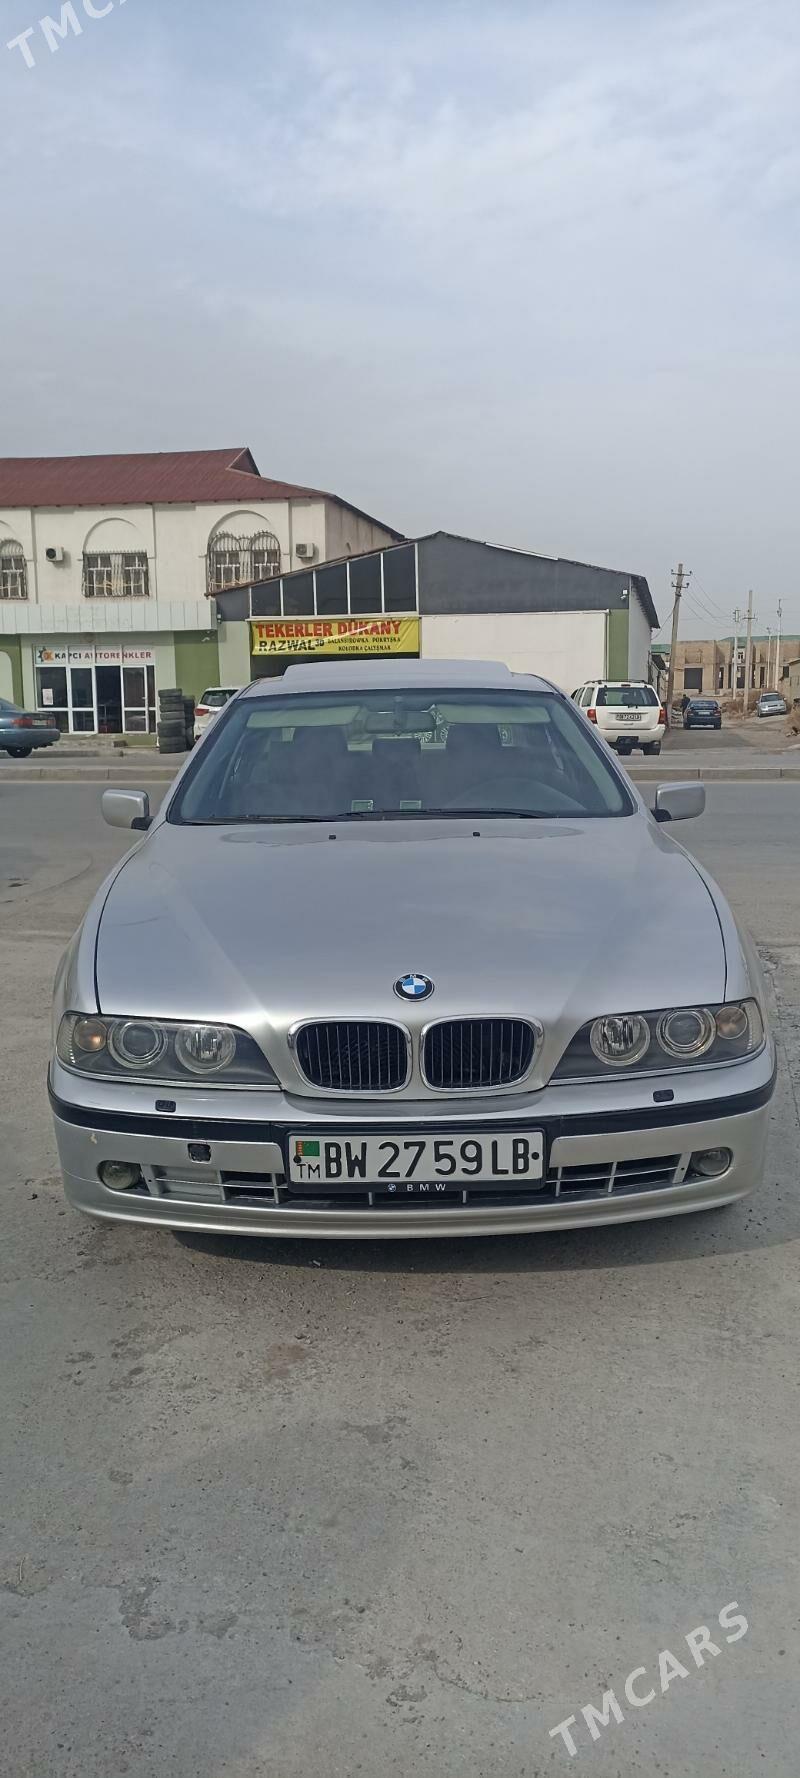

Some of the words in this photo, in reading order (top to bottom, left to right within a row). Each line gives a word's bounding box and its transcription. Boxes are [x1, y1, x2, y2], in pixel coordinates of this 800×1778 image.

[257, 623, 333, 638] TEKERLER
[338, 619, 401, 636] DÜKANY
[258, 640, 316, 652] RAZWAL
[296, 1163, 321, 1179] TM
